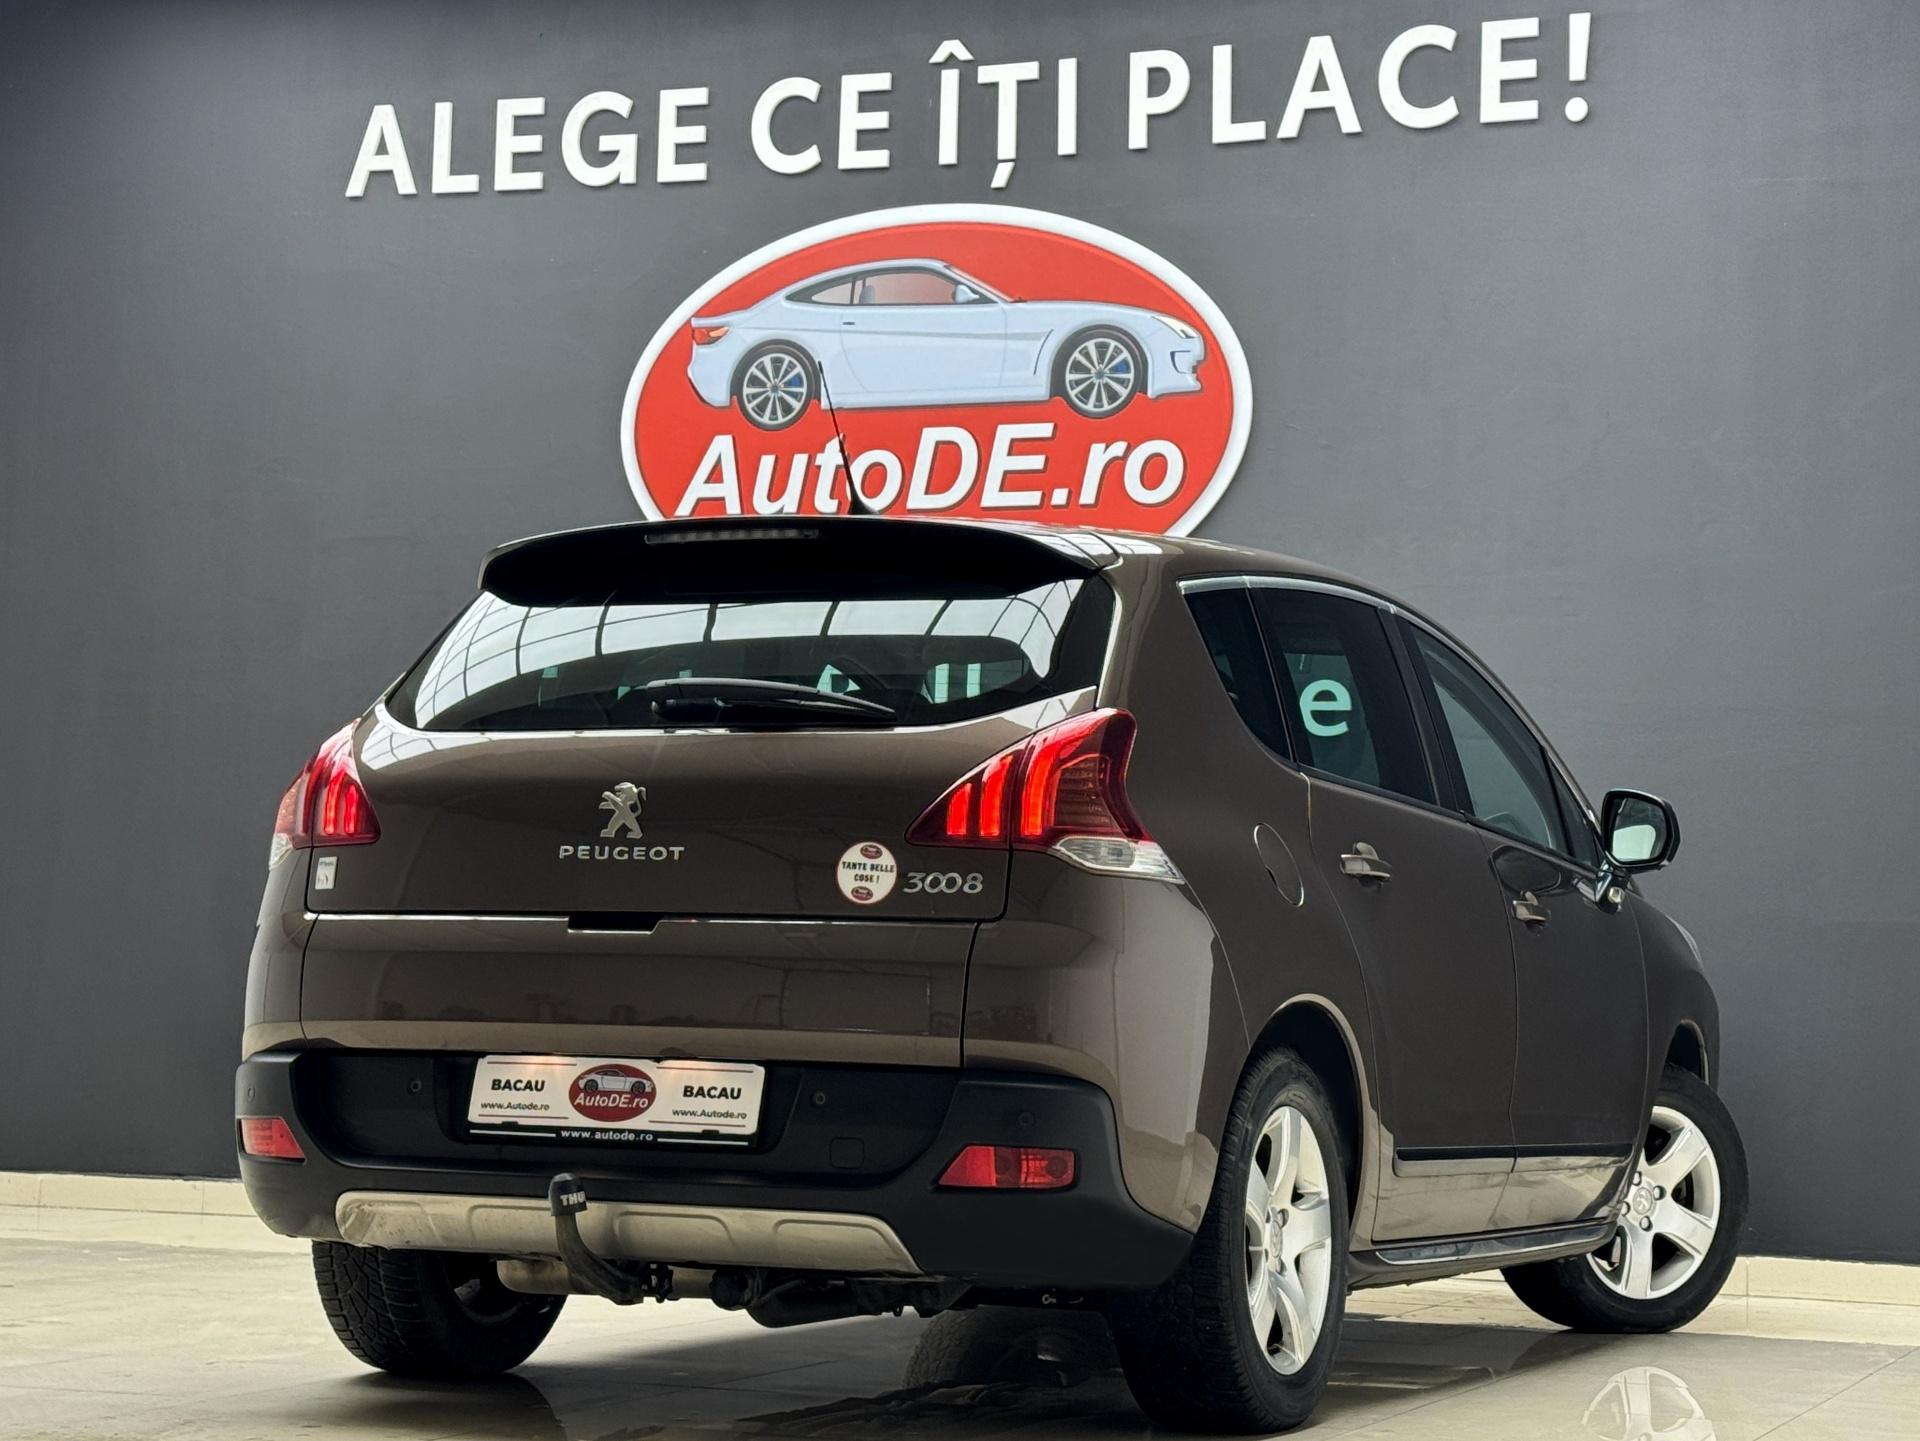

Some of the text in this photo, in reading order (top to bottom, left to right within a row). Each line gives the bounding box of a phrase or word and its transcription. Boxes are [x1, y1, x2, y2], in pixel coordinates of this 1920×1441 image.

[345, 85, 710, 198] ALEGE
[750, 71, 893, 175] CE
[1127, 12, 1592, 151] PLACE!
[675, 421, 1184, 515] AutoDE.ro
[558, 844, 685, 861] PEUGEOT
[841, 861, 895, 873] TANTE BELLE
[853, 873, 875, 882] COSE
[903, 871, 984, 894] 3008
[491, 1078, 546, 1092] BACAU
[682, 1085, 742, 1100] BACAU
[480, 1101, 550, 1112] www.Autode.ro
[574, 1092, 649, 1109] AutoDE.ro
[672, 1108, 748, 1120] www.Autode.ro
[560, 1129, 654, 1142] www.autode.ro
